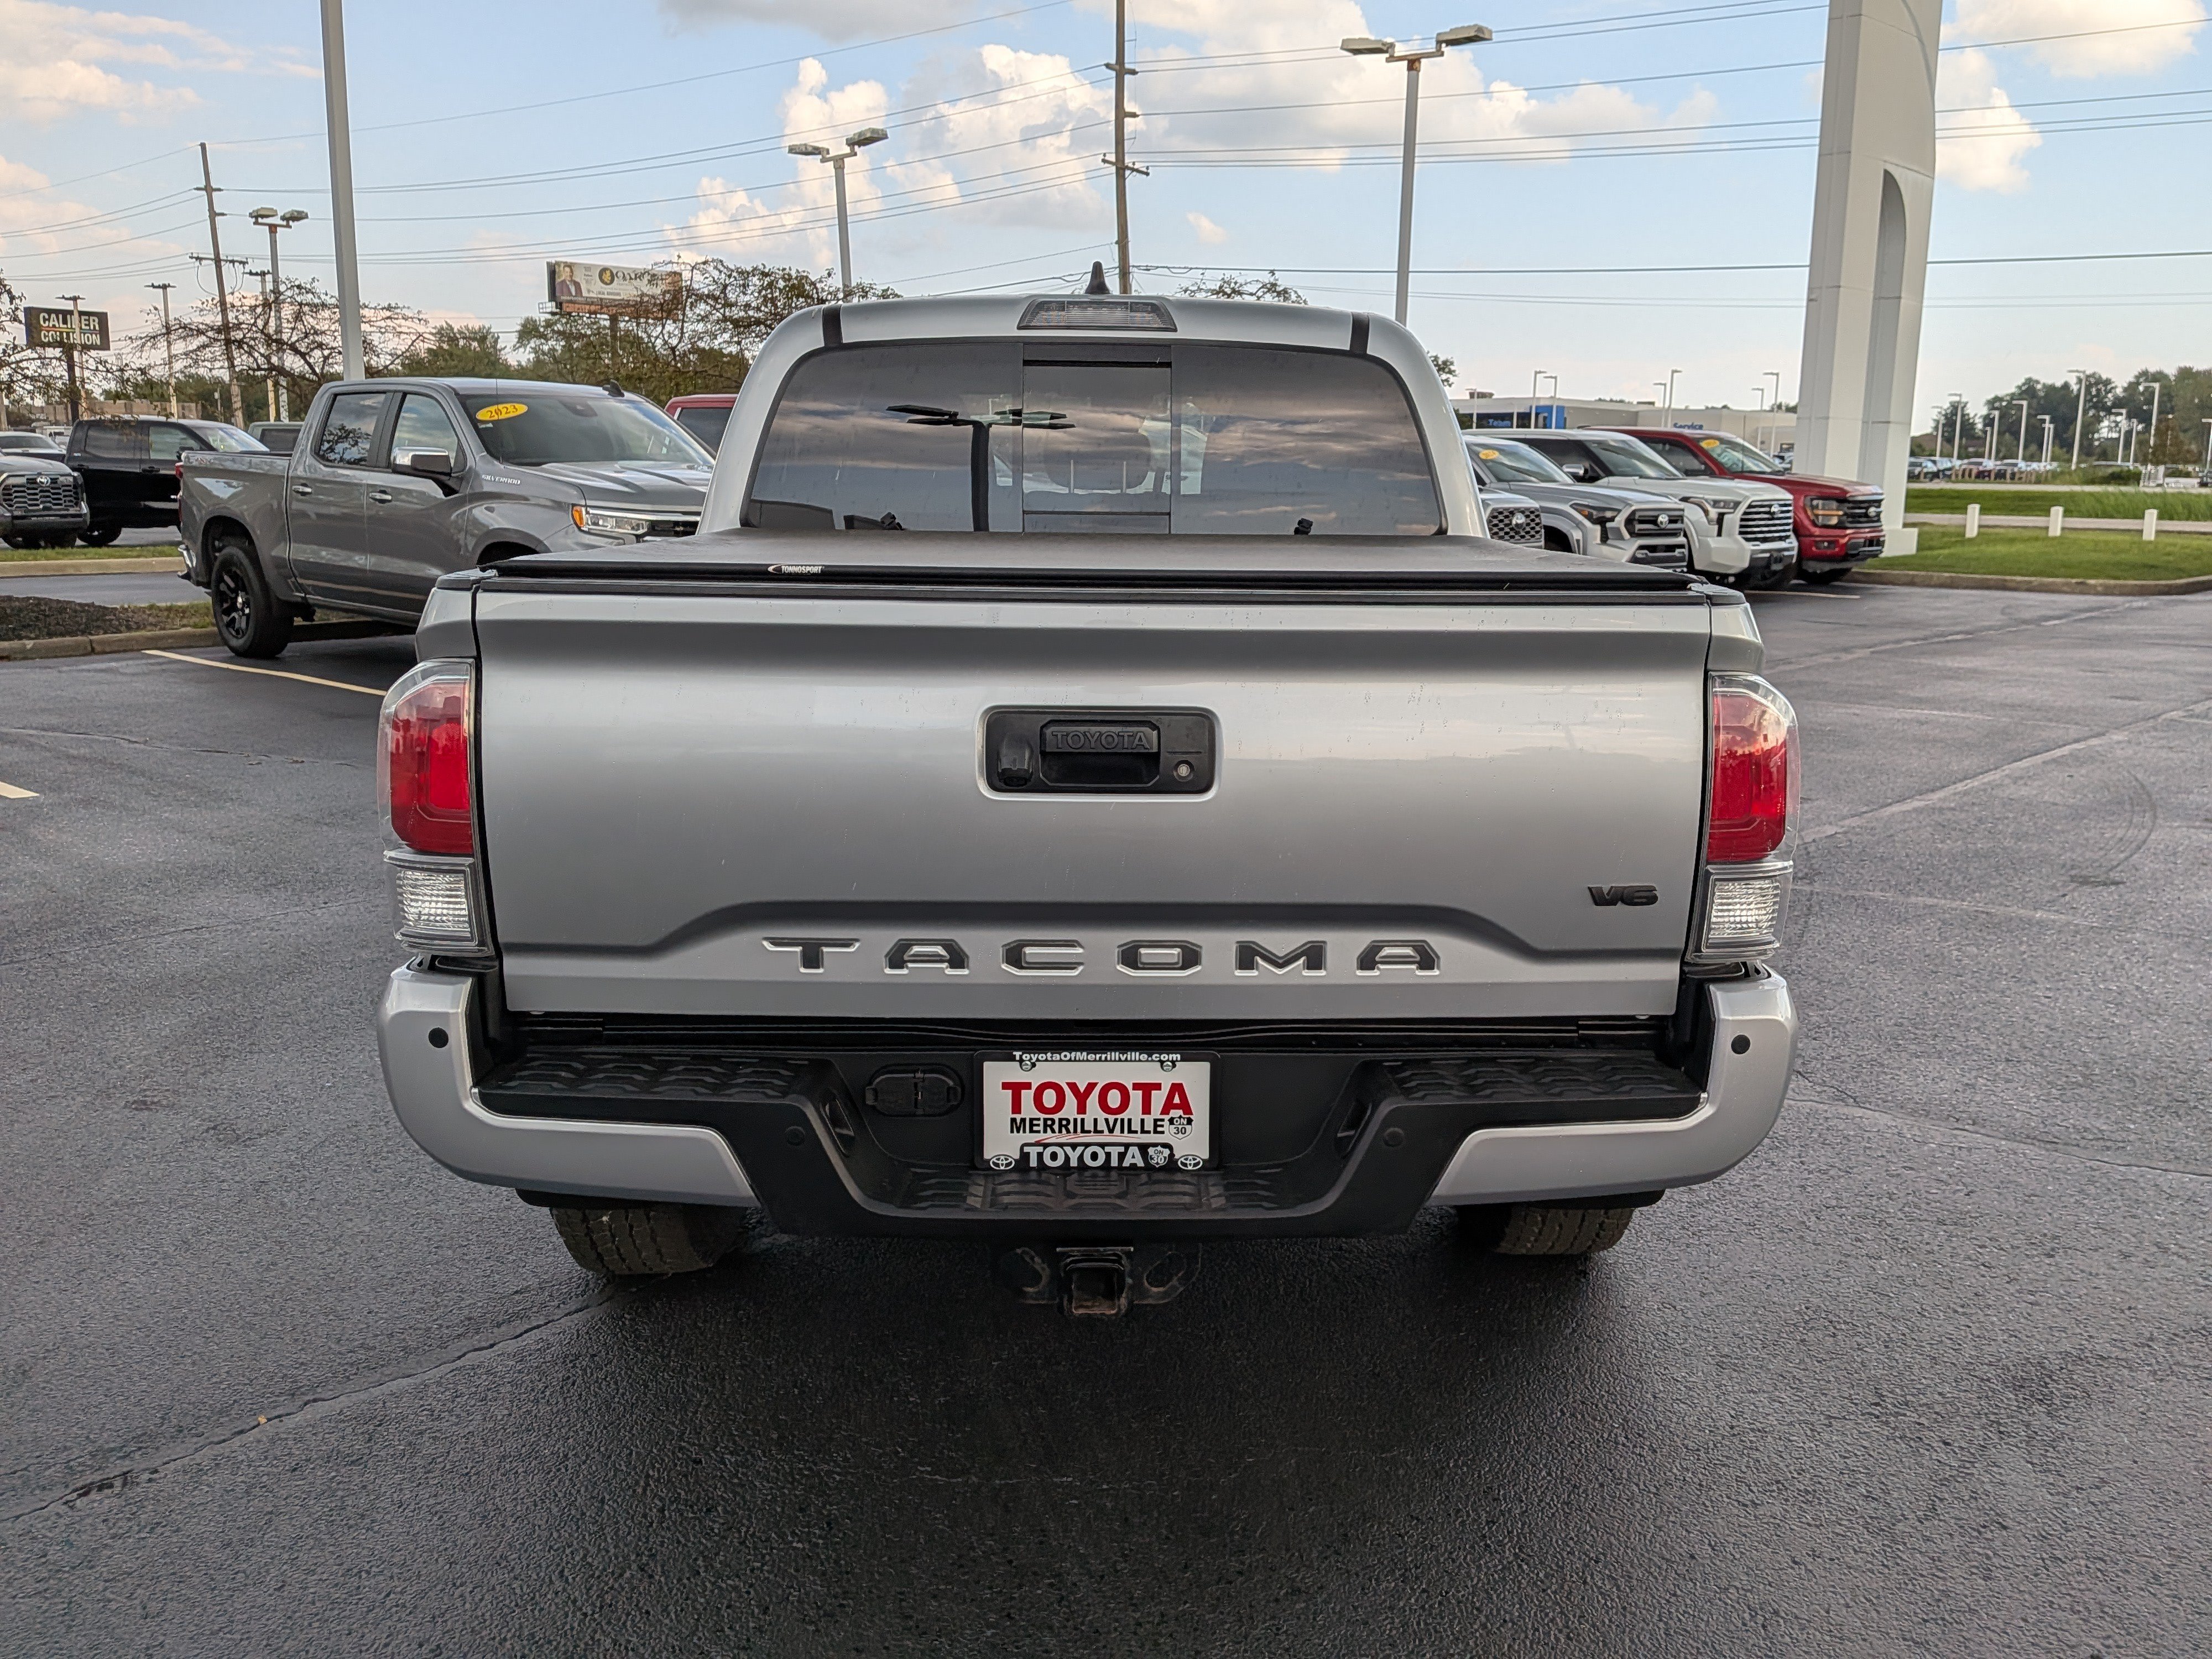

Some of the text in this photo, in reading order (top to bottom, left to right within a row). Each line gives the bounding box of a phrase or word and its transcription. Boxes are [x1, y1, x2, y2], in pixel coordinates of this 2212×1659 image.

[486, 404, 518, 419] 2023
[1052, 731, 1151, 750] TOYOTA
[1588, 885, 1658, 906] V6
[762, 937, 1441, 976] TACOMA
[1013, 1051, 1181, 1062] ToyotaOfMerrillville.com
[1001, 1081, 1193, 1116] TOYOTA
[1010, 1117, 1165, 1135] MERRILLVILLE
[1173, 1126, 1187, 1135] 30
[1024, 1146, 1145, 1167] TOYOTA
[1151, 1155, 1165, 1164] 30
